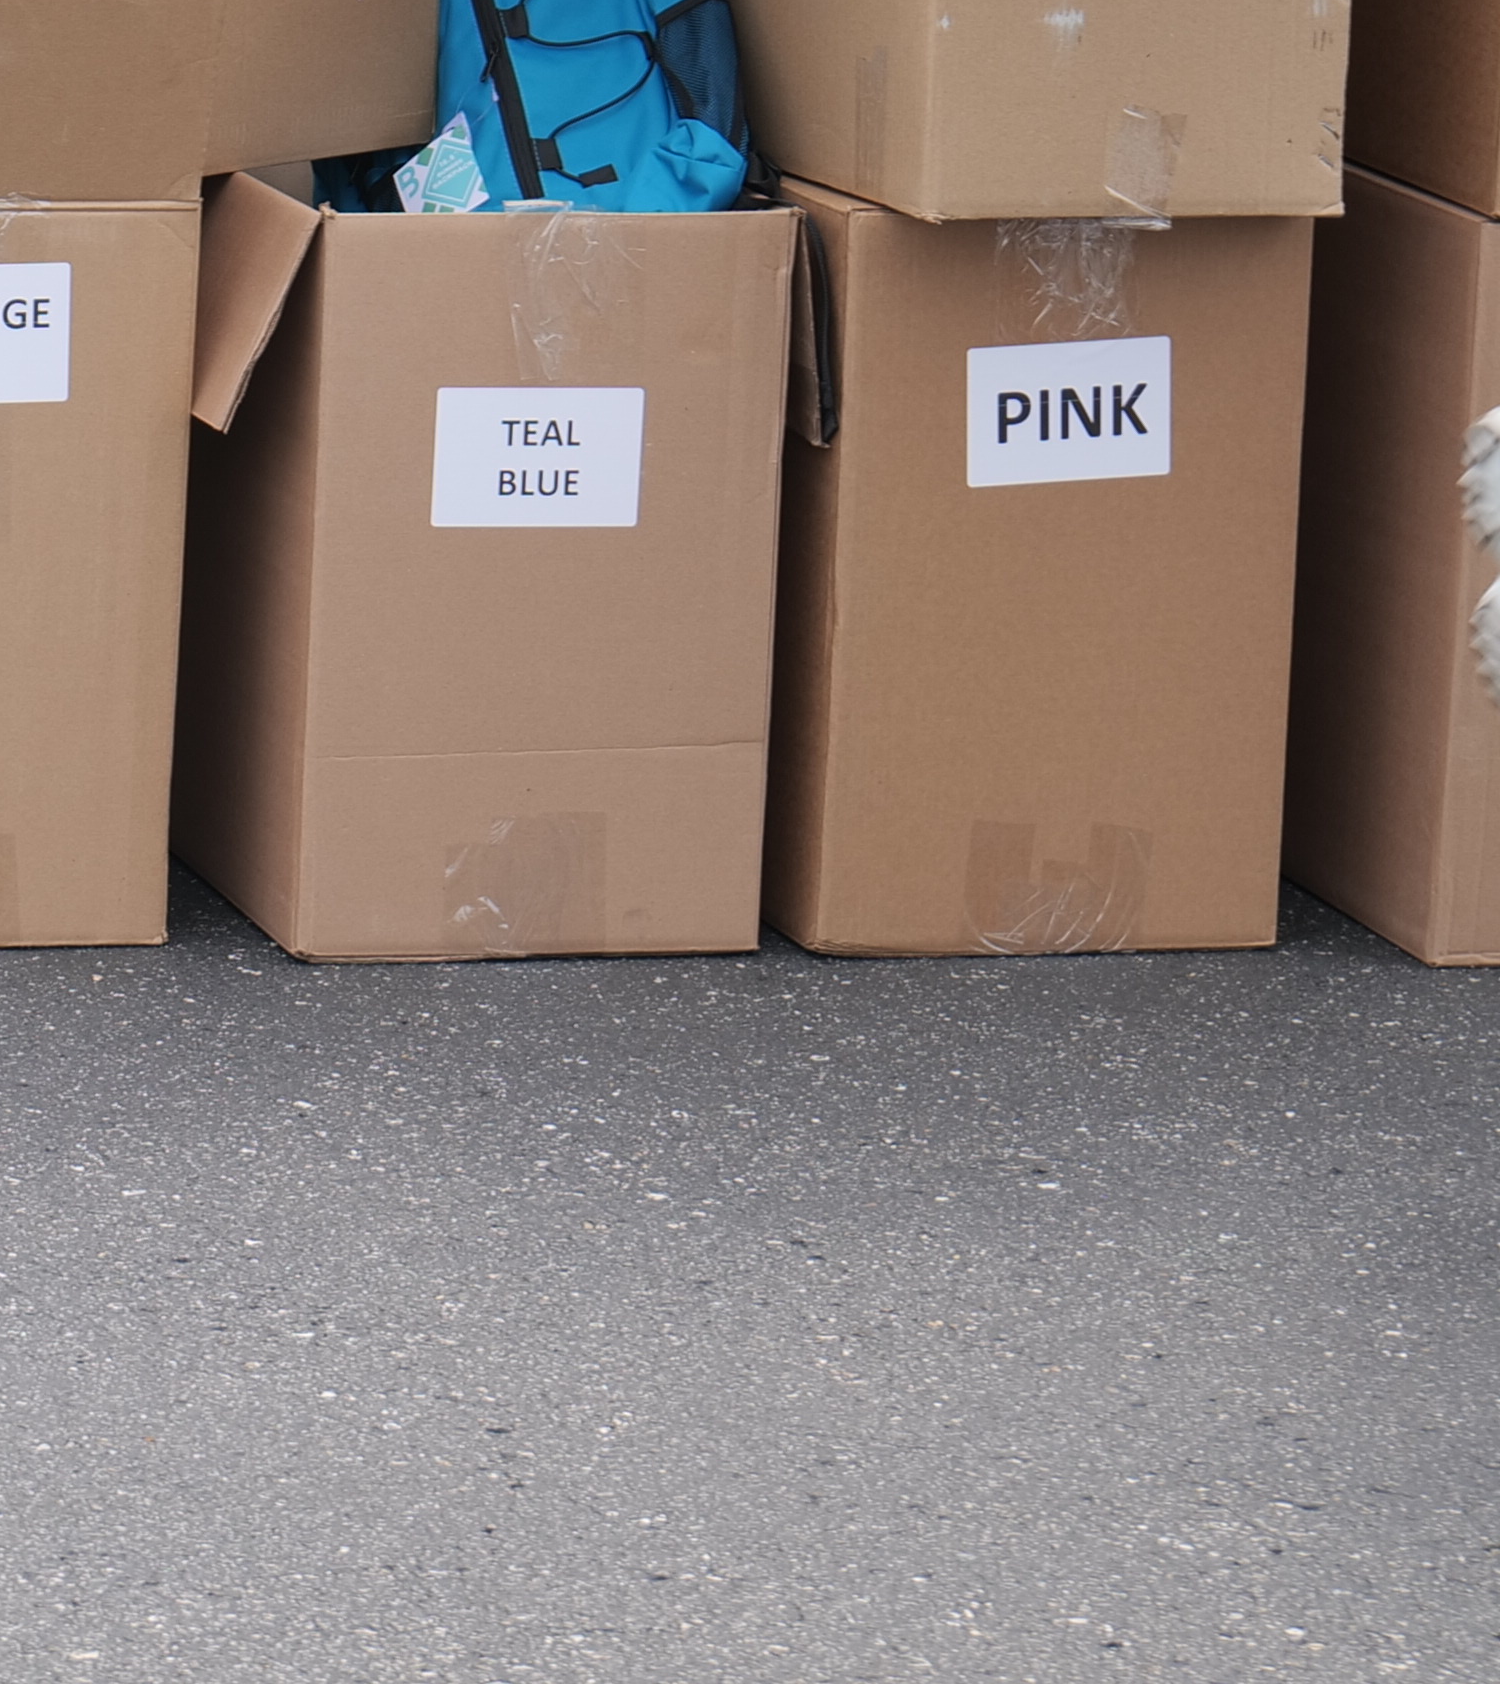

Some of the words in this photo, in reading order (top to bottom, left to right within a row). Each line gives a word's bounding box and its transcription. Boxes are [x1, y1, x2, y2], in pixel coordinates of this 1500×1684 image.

[996, 382, 1150, 445] PINK
[501, 419, 582, 447] TEAL
[498, 468, 581, 498] BLUE
